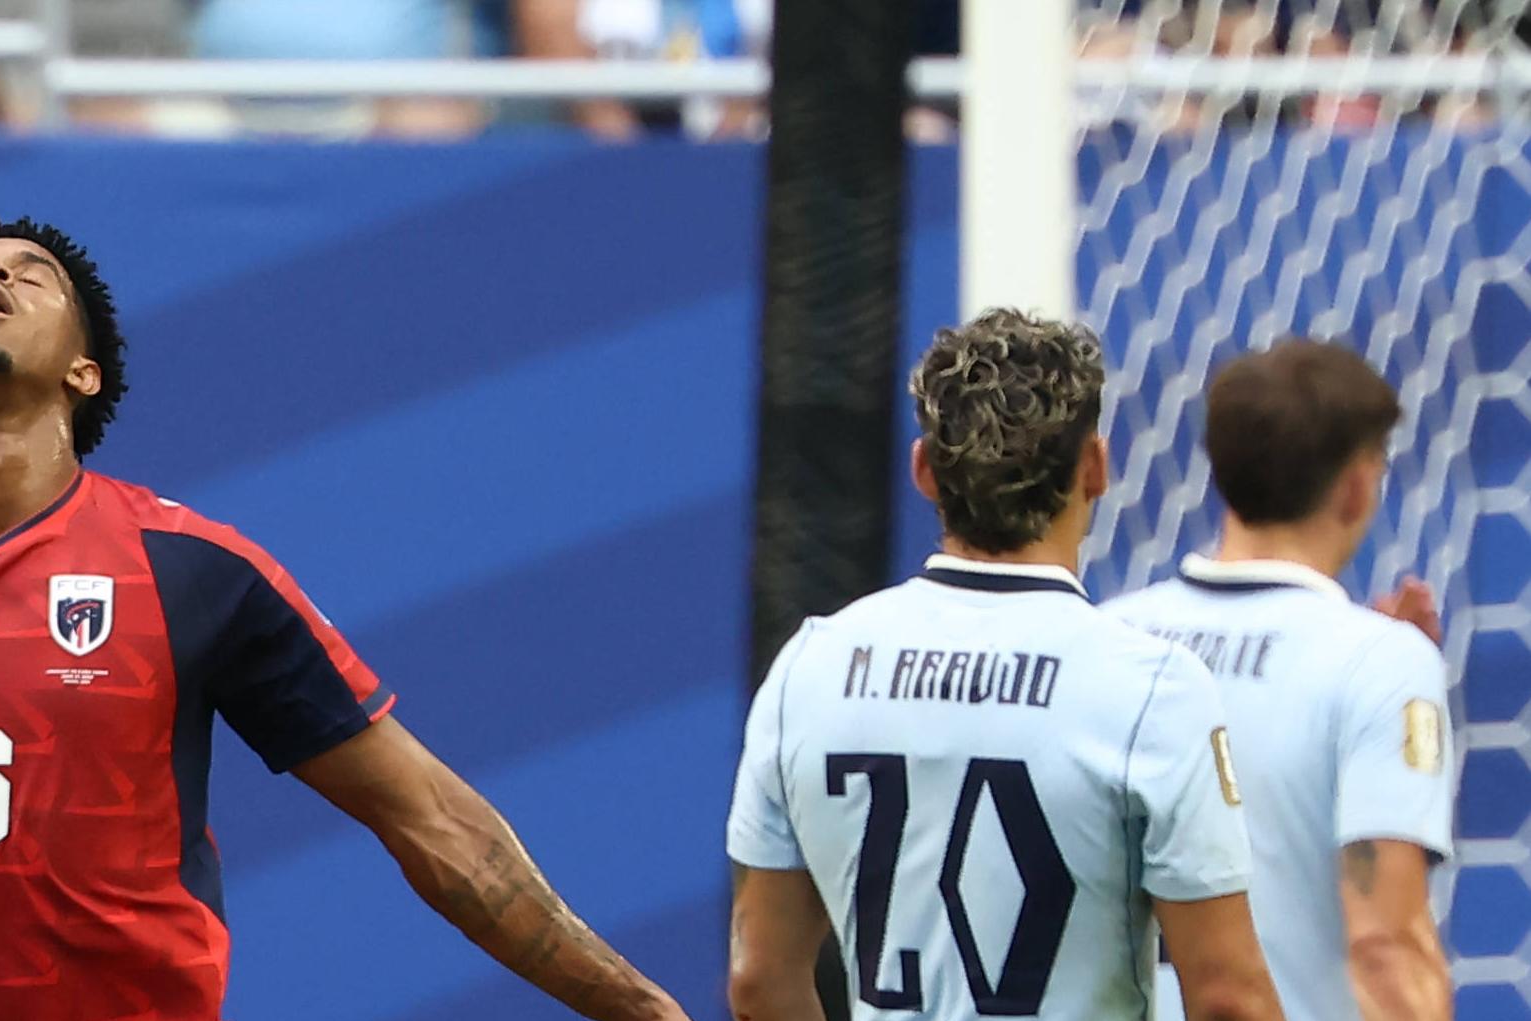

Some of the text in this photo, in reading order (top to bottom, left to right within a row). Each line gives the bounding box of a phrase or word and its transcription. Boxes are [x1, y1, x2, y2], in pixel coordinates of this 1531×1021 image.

[843, 646, 1062, 709] M. ARAUJO
[824, 752, 1077, 1018] 20
